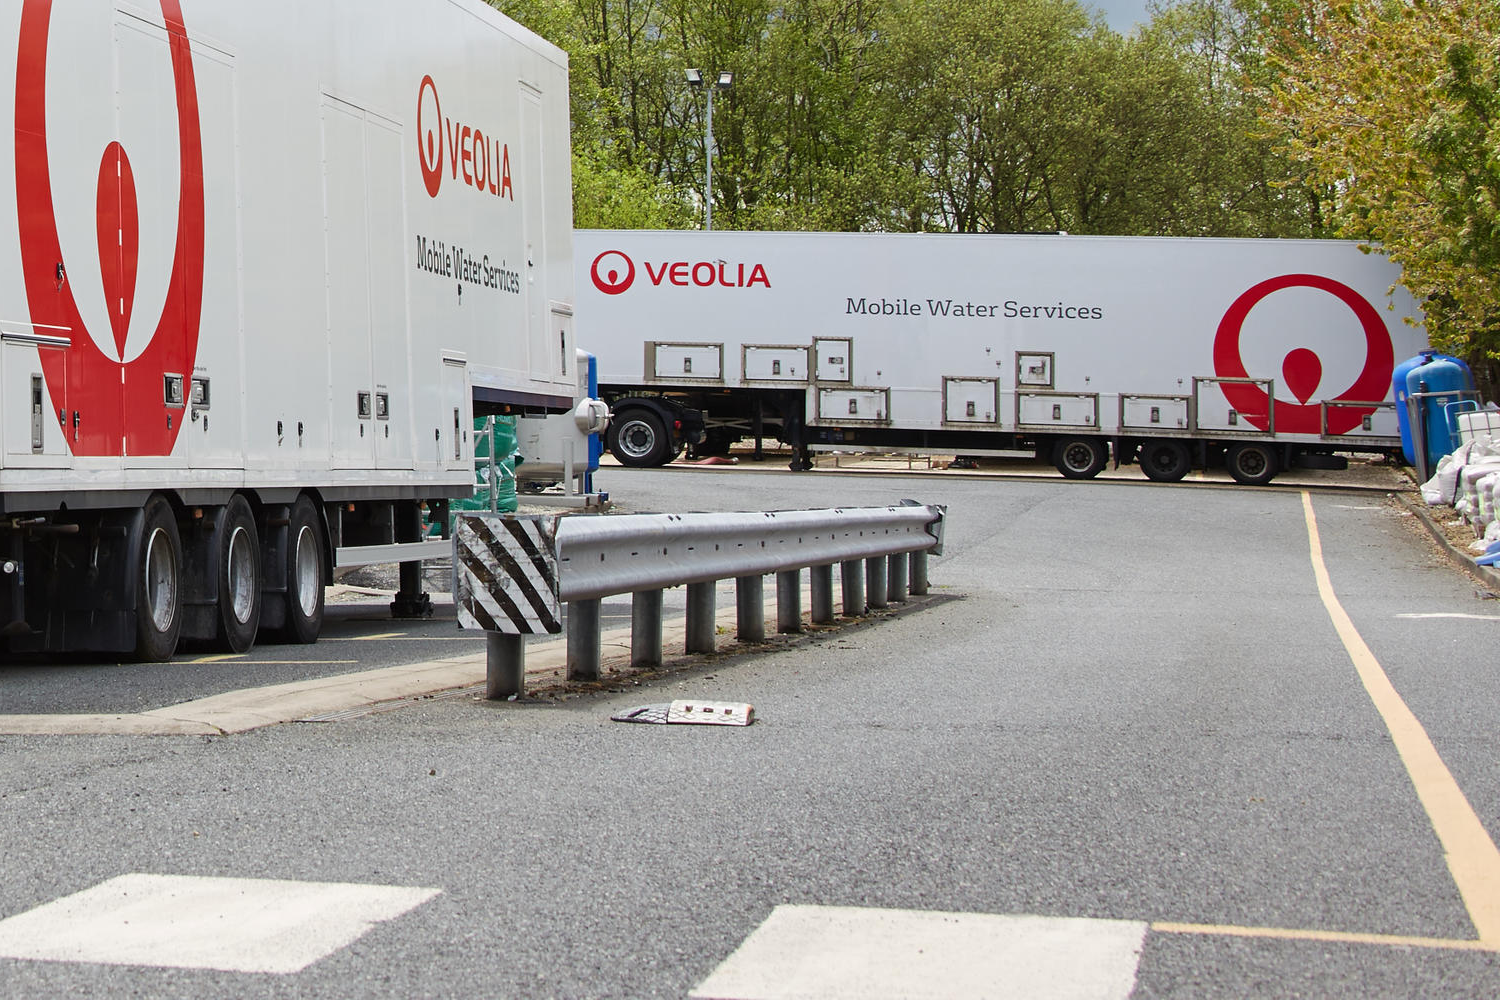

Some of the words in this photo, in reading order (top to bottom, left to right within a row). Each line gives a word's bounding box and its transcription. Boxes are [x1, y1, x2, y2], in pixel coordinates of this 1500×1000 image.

[446, 117, 513, 201] VEOLIA
[416, 235, 451, 278] Mobile
[452, 246, 481, 285] Water
[483, 255, 519, 294] Services
[644, 262, 771, 288] VEOLIA
[845, 298, 922, 317] Mobile
[927, 300, 998, 318] Water
[1003, 301, 1103, 320] Services
